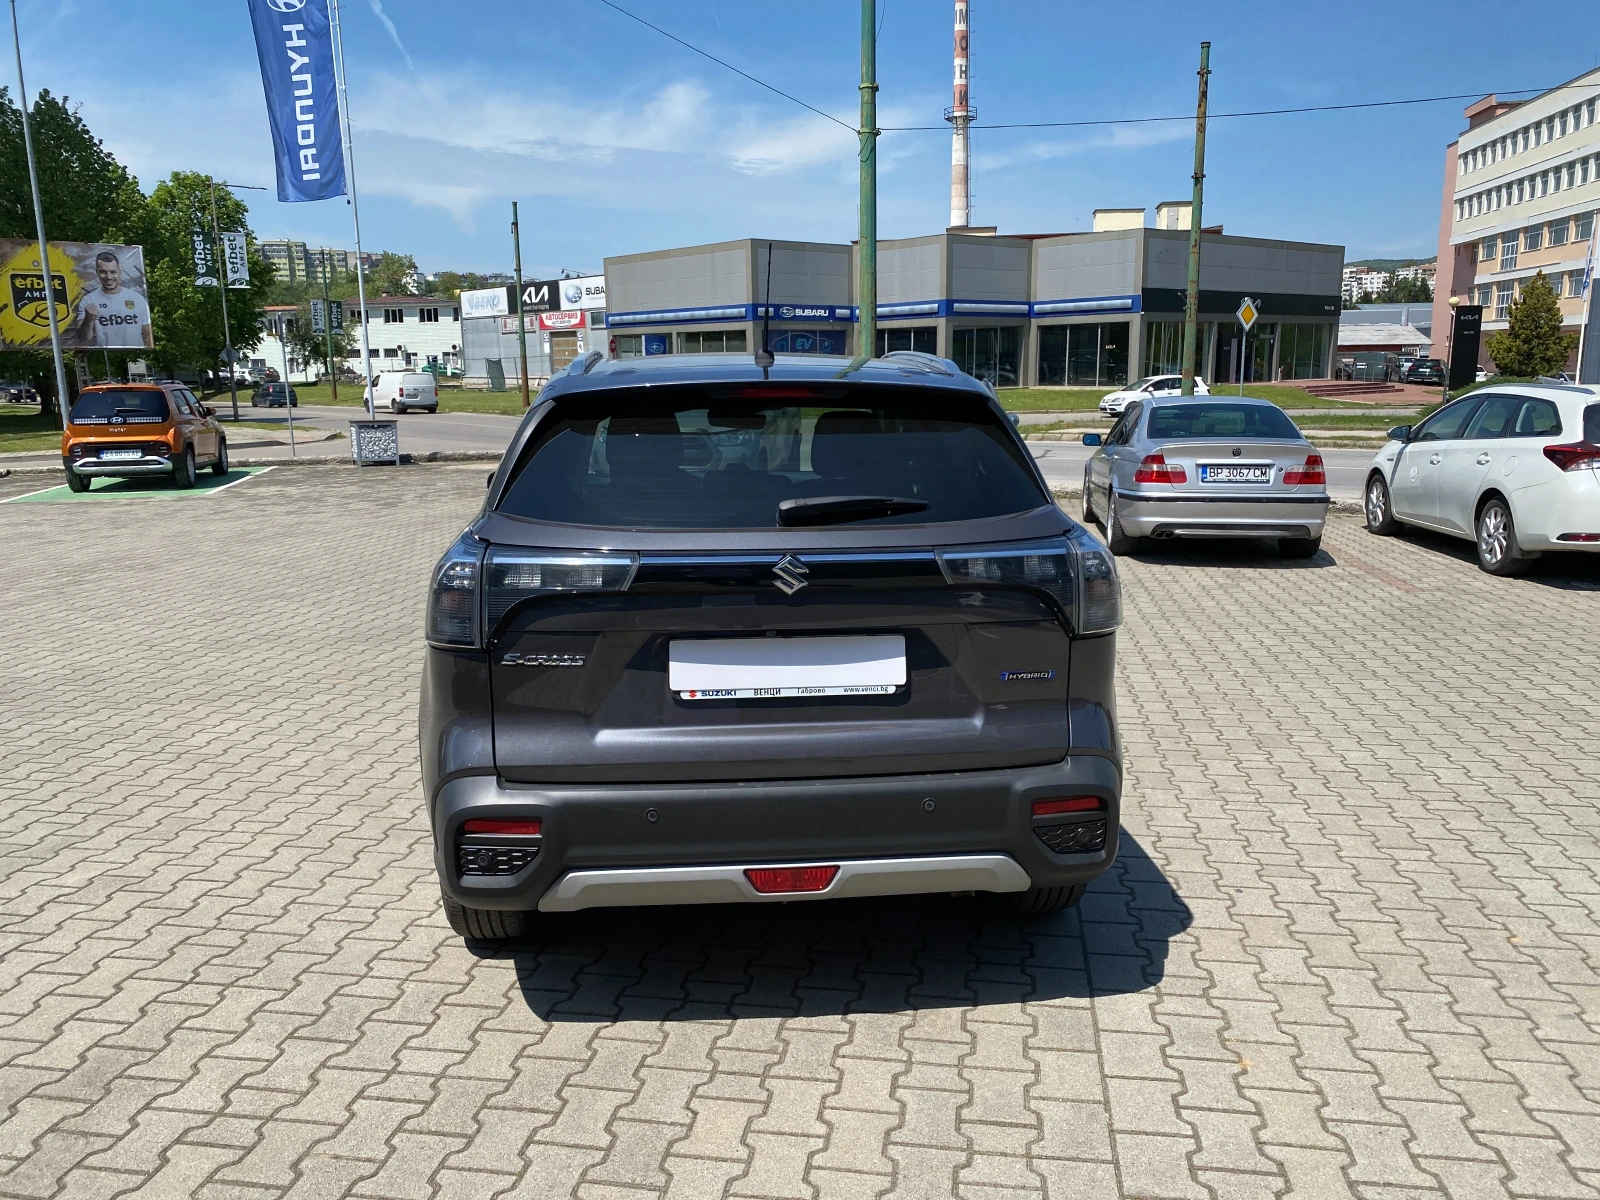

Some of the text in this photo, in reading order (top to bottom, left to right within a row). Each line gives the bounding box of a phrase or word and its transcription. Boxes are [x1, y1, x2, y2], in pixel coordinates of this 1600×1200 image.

[282, 23, 321, 181] HYUNDAI
[192, 234, 206, 274] efbet
[226, 236, 239, 274] efbet
[14, 277, 62, 289] efbt
[585, 286, 606, 296] SUBA
[545, 312, 579, 321] АВТОСЕРВИЗ
[795, 309, 829, 317] SUBARU
[99, 314, 138, 326] efbet
[796, 338, 813, 350] EV
[1209, 467, 1223, 478] BP
[1225, 467, 1252, 478] 3067
[1253, 467, 1267, 478] CM
[1008, 672, 1048, 680] HYBRID
[701, 689, 737, 697] SUZUKI
[753, 688, 781, 697] ВЕНЦИ
[843, 685, 889, 693] www.venci.bg
